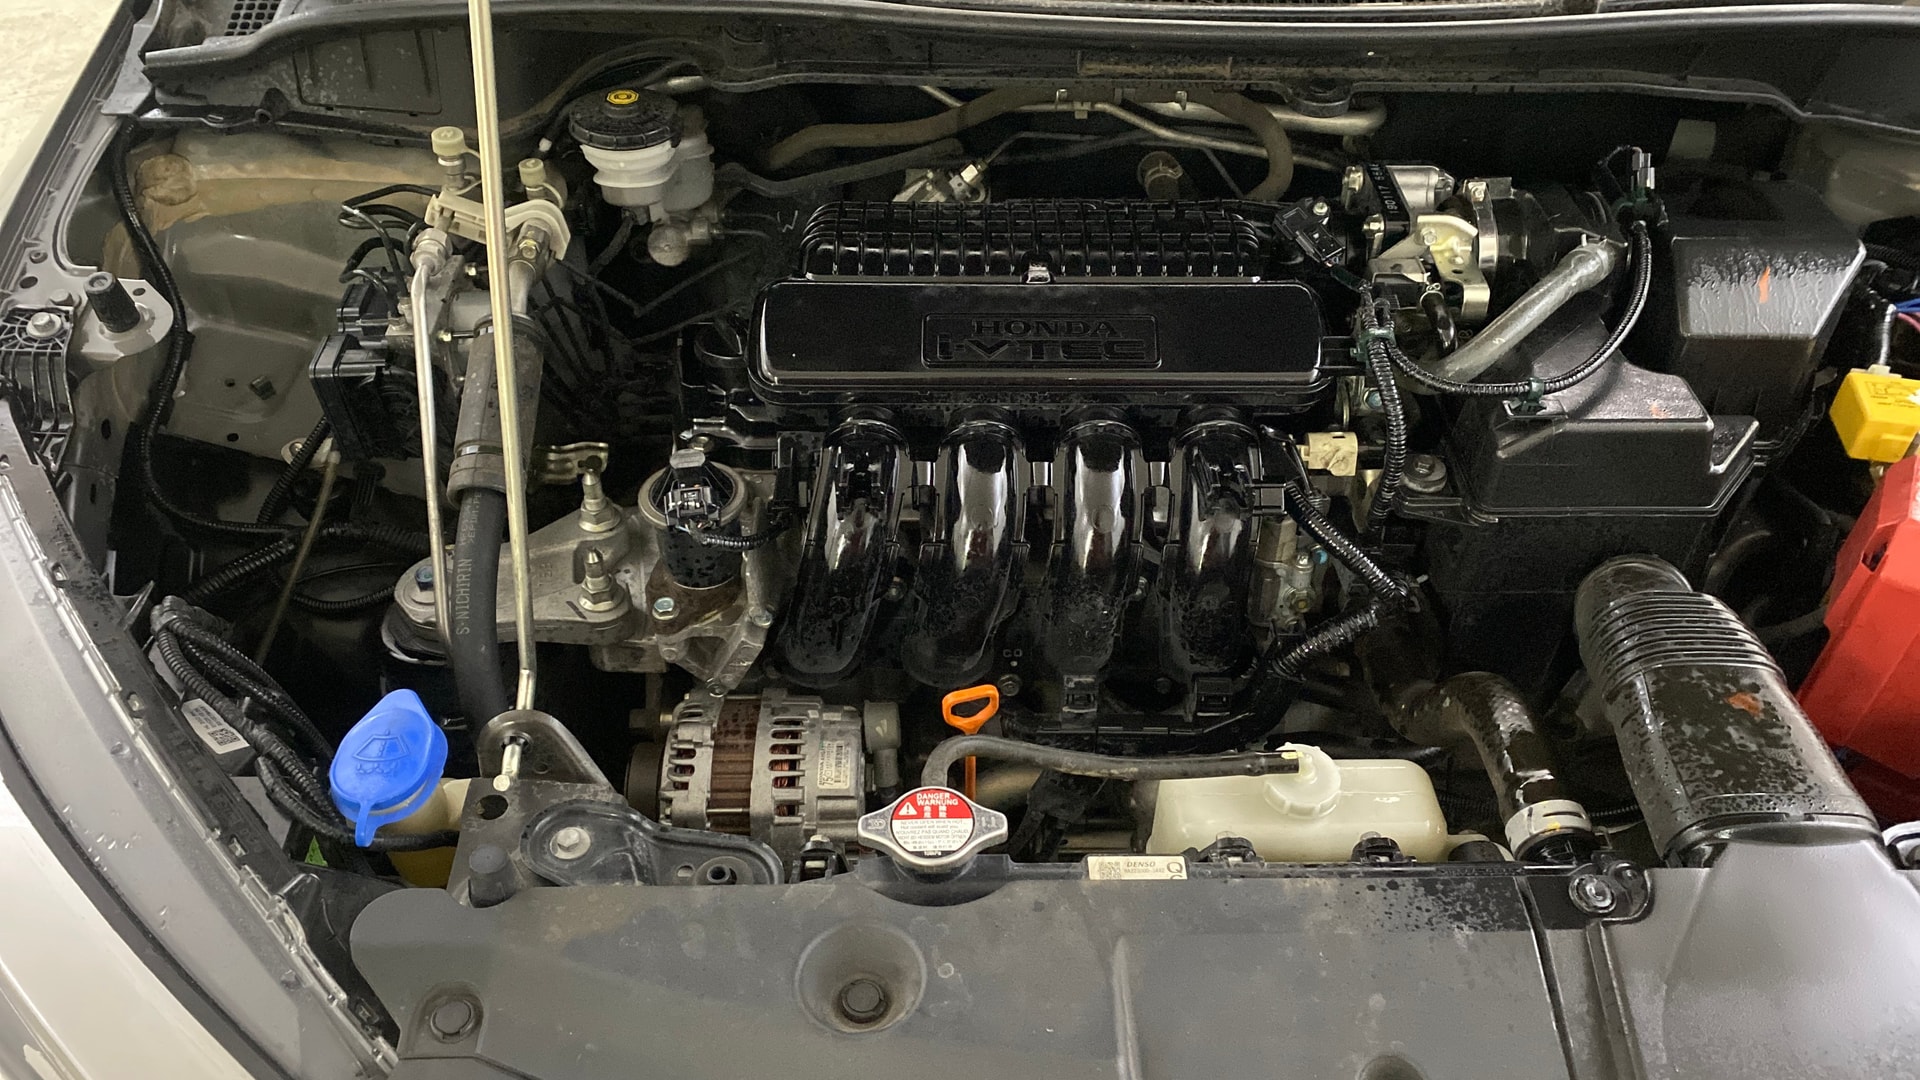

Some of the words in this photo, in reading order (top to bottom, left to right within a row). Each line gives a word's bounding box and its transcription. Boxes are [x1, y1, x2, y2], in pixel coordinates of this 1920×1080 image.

[972, 319, 1123, 338] HONDA
[916, 792, 951, 800] DANGER
[916, 799, 959, 807] WARNUNG
[1166, 861, 1184, 874] Q
